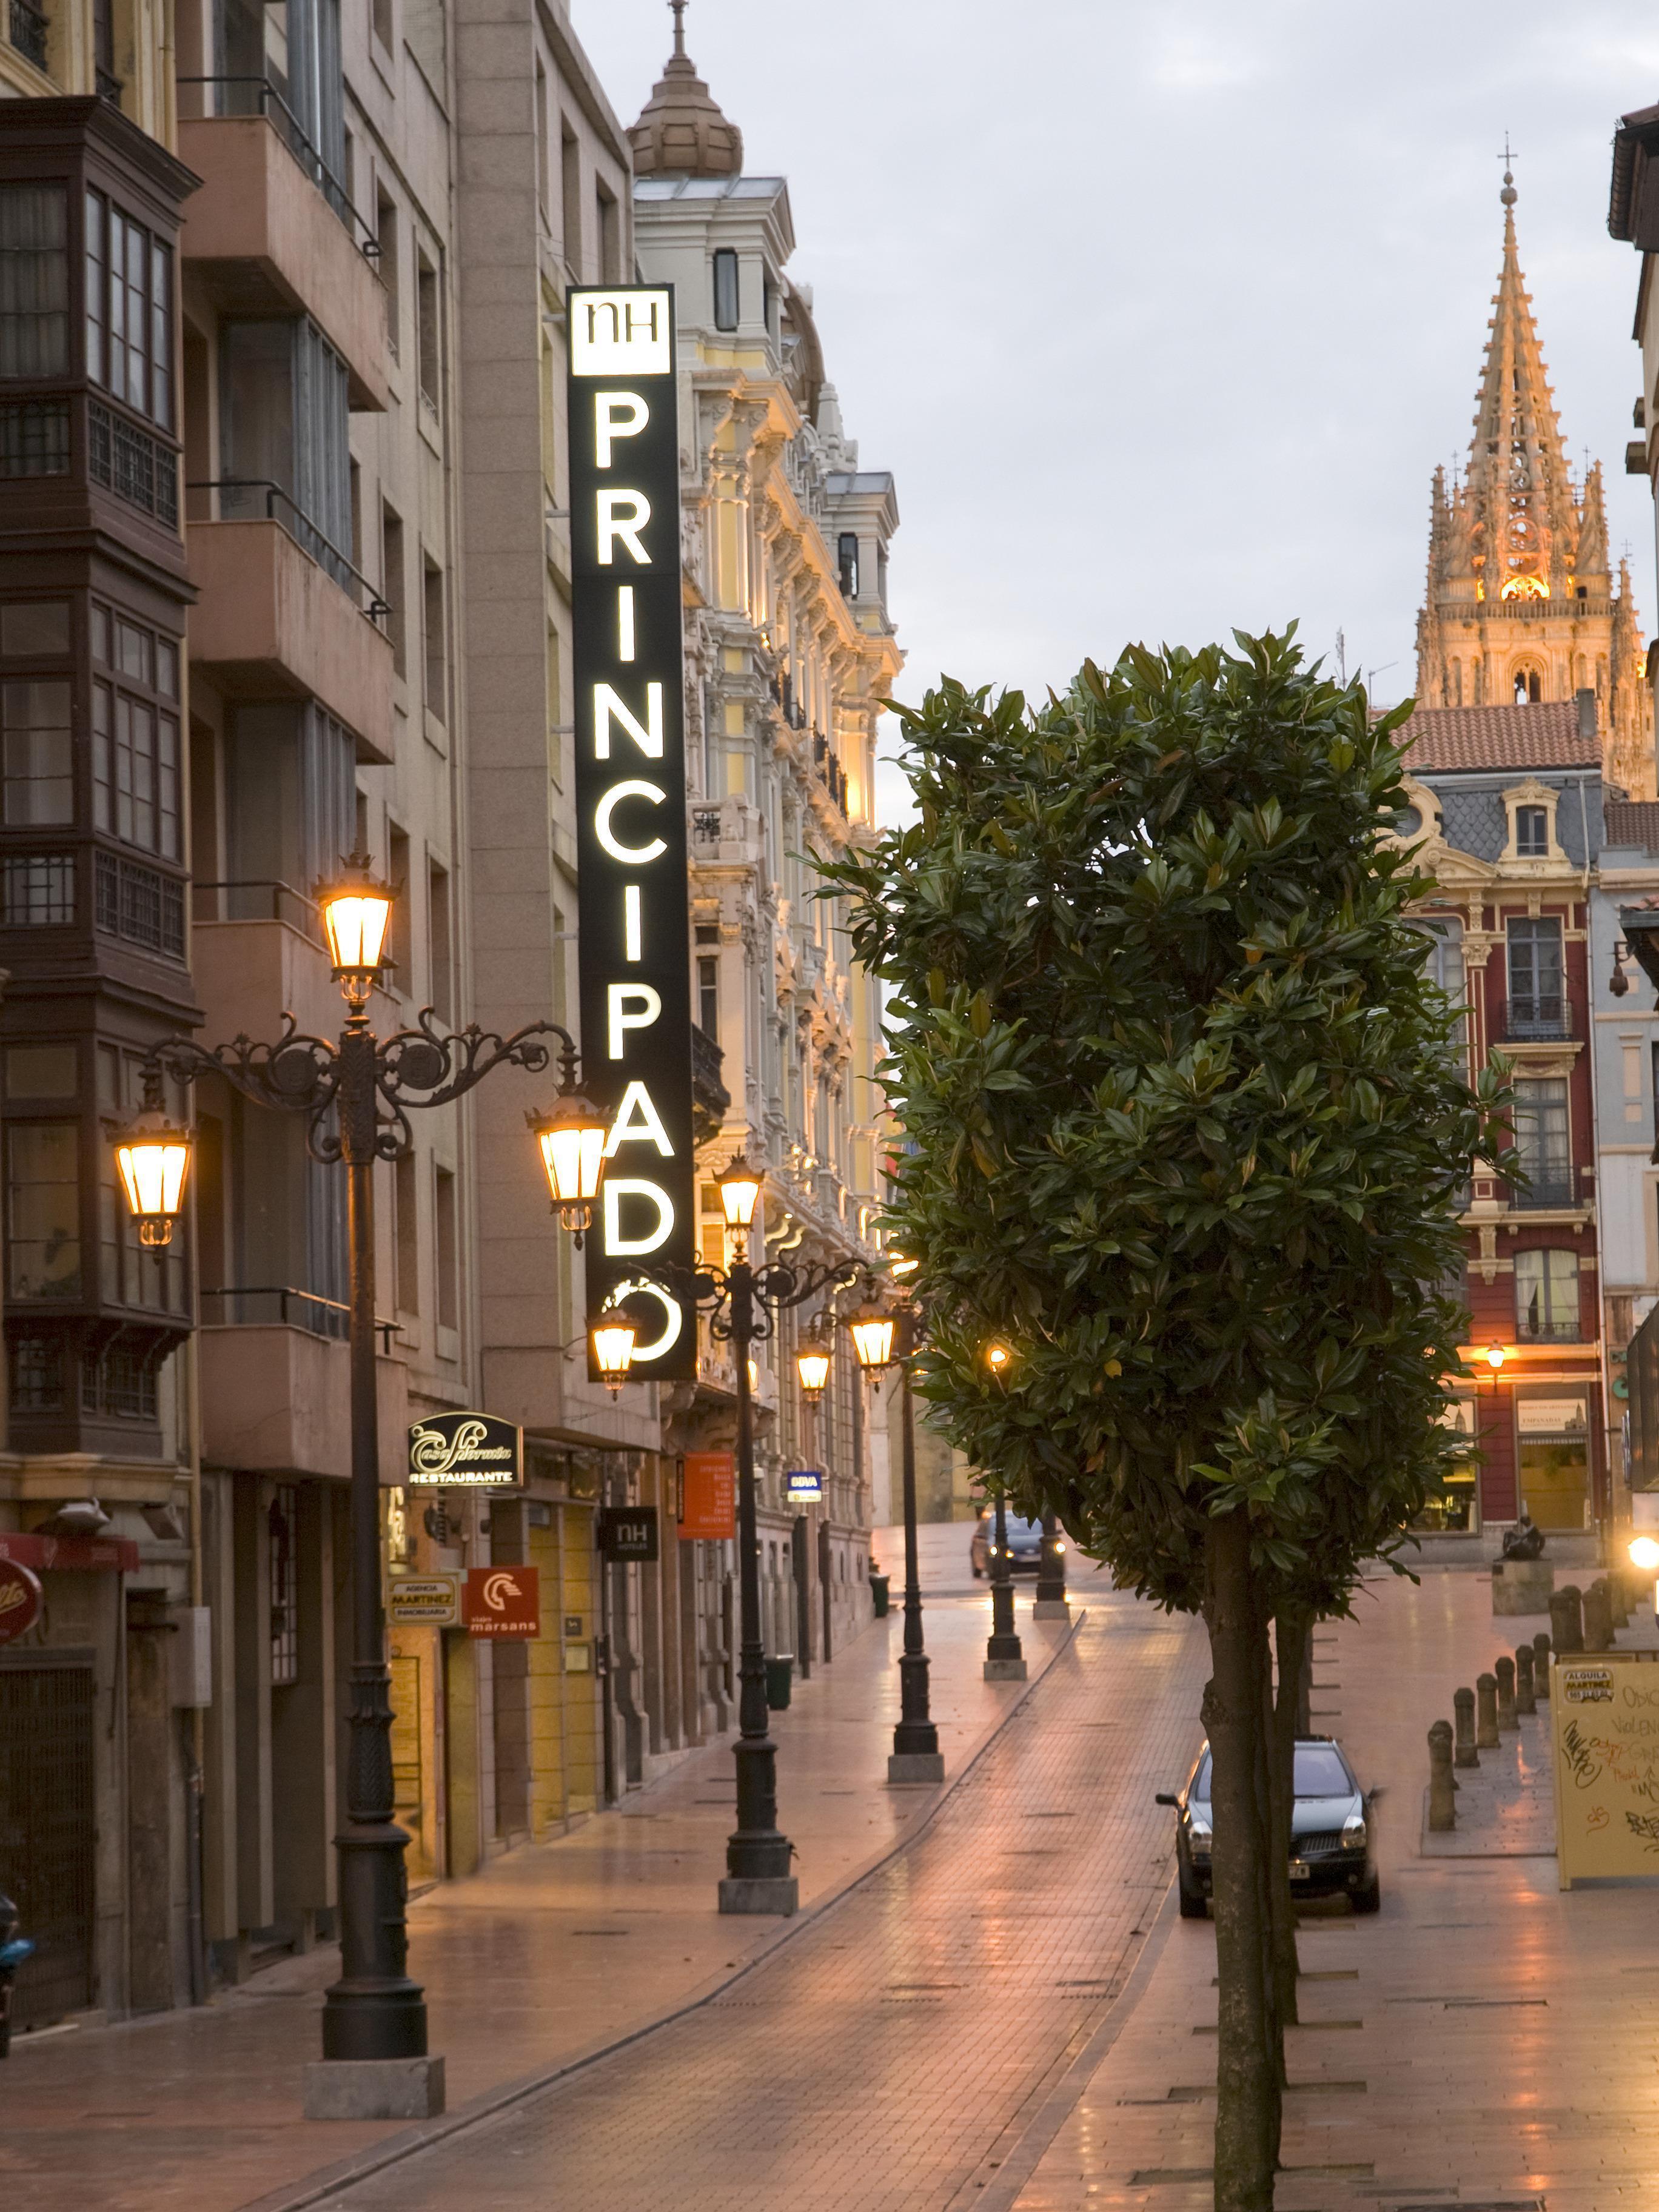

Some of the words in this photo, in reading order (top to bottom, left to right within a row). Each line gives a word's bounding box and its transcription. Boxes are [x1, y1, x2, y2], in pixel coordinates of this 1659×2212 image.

[595, 392, 682, 1362] PRINCIPADO
[409, 1472, 512, 1483] RESTAURANTE
[471, 1622, 536, 1632] marsans
[1569, 1672, 1607, 1680] ALQUILA
